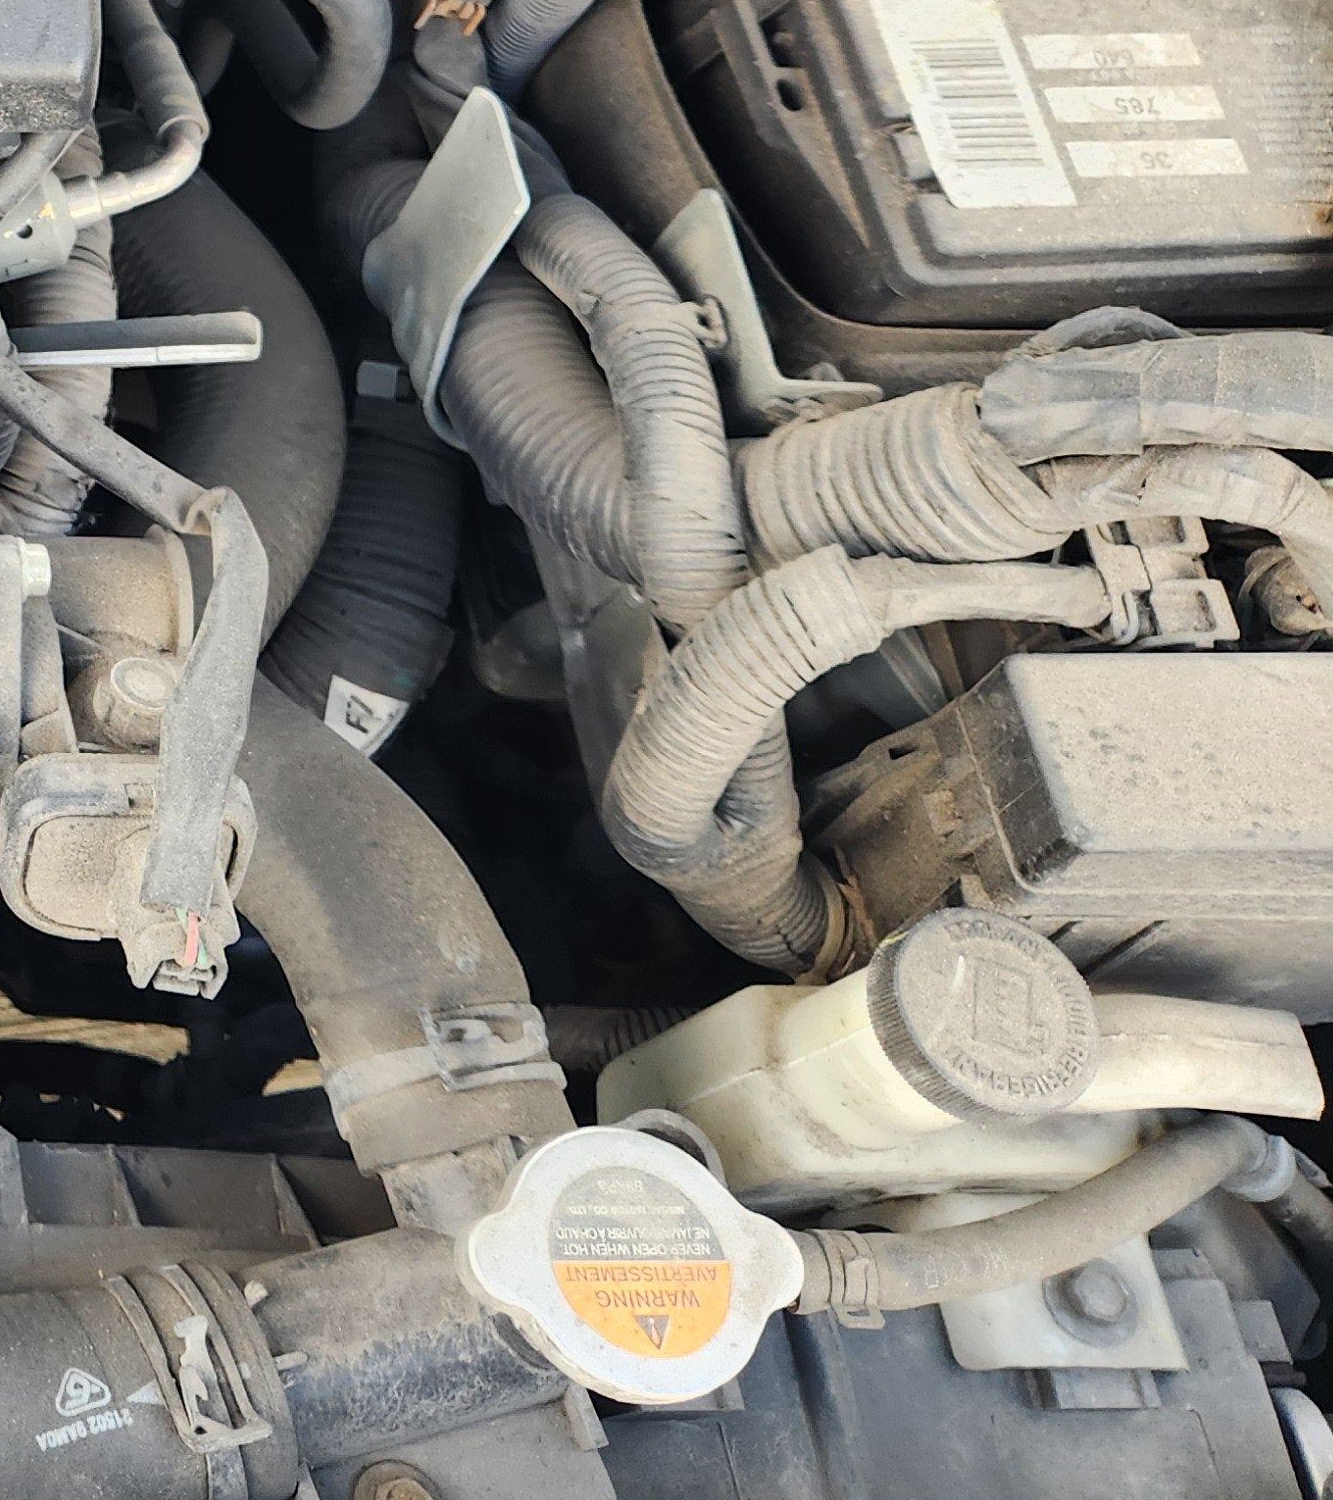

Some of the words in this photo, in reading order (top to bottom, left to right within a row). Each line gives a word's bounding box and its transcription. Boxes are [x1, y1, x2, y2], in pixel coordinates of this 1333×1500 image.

[1113, 96, 1161, 116] 785
[591, 1243, 632, 1257] WHEN
[632, 1243, 668, 1256] OPEN
[670, 1243, 711, 1256] NEVER
[566, 1266, 718, 1283] AVERTISSEMENT
[595, 1289, 701, 1309] WARNING
